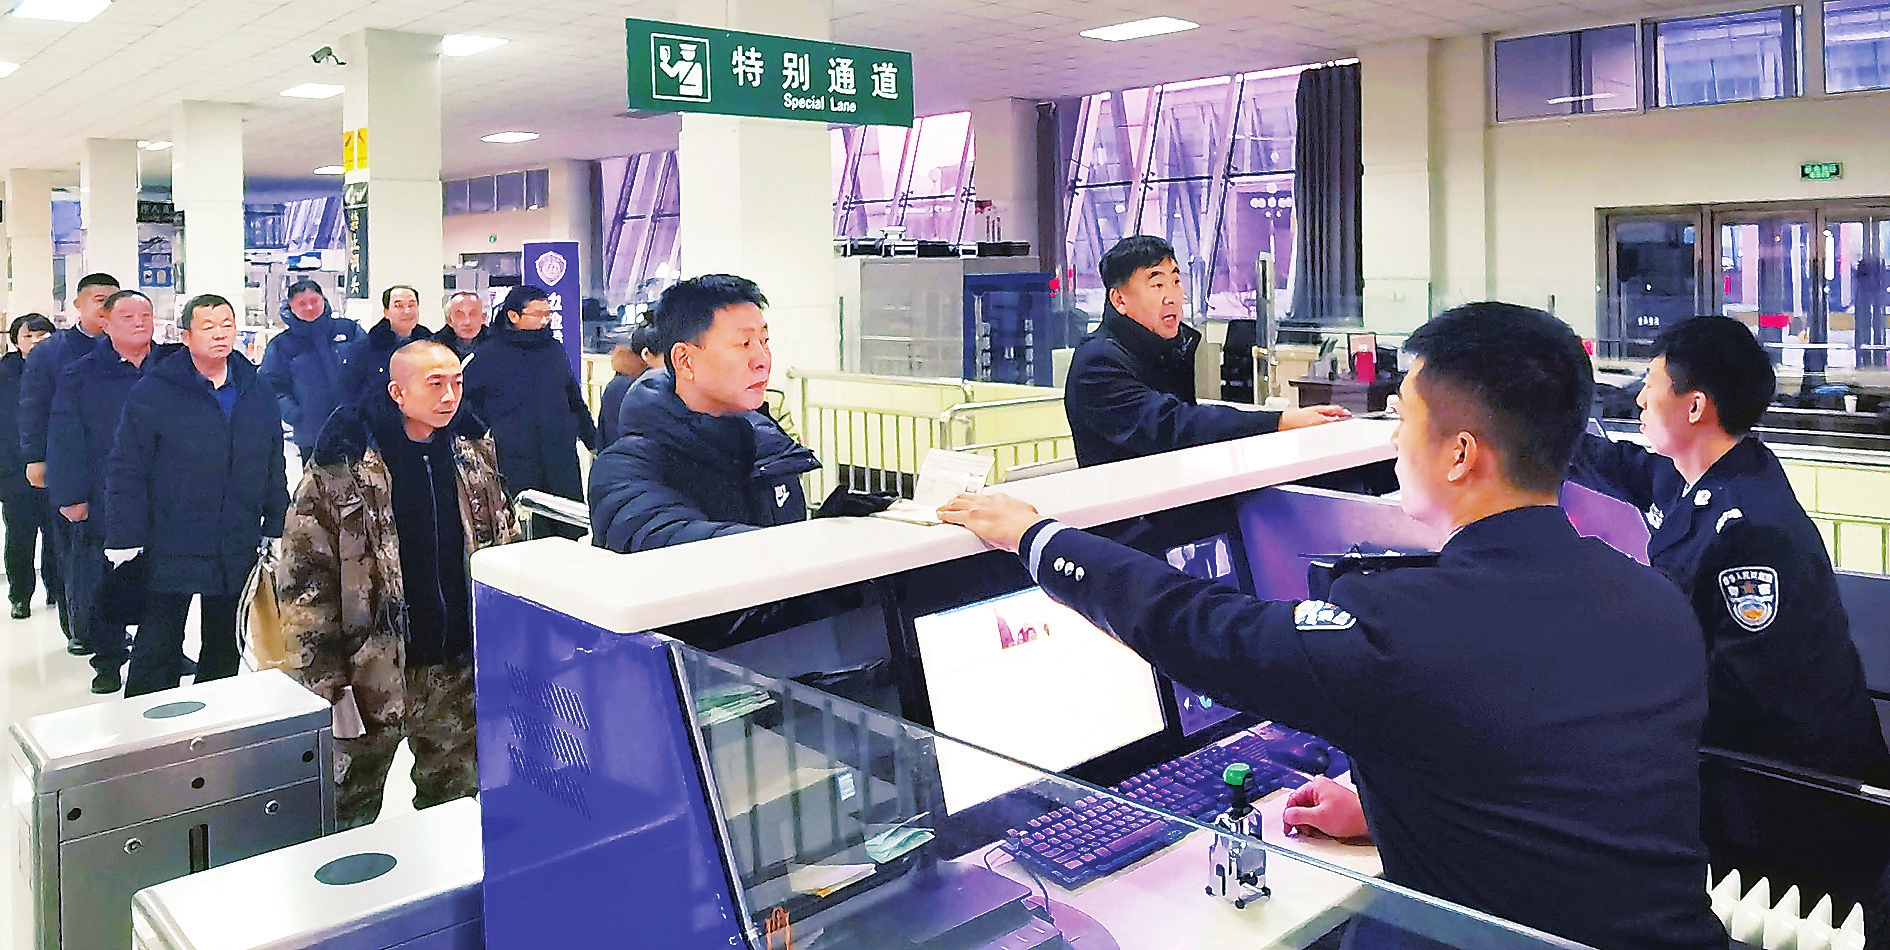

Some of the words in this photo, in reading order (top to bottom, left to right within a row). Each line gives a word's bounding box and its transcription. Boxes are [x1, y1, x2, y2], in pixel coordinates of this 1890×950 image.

[731, 45, 899, 100] 特别通道
[782, 92, 825, 111] Special
[829, 95, 857, 113] Lane
